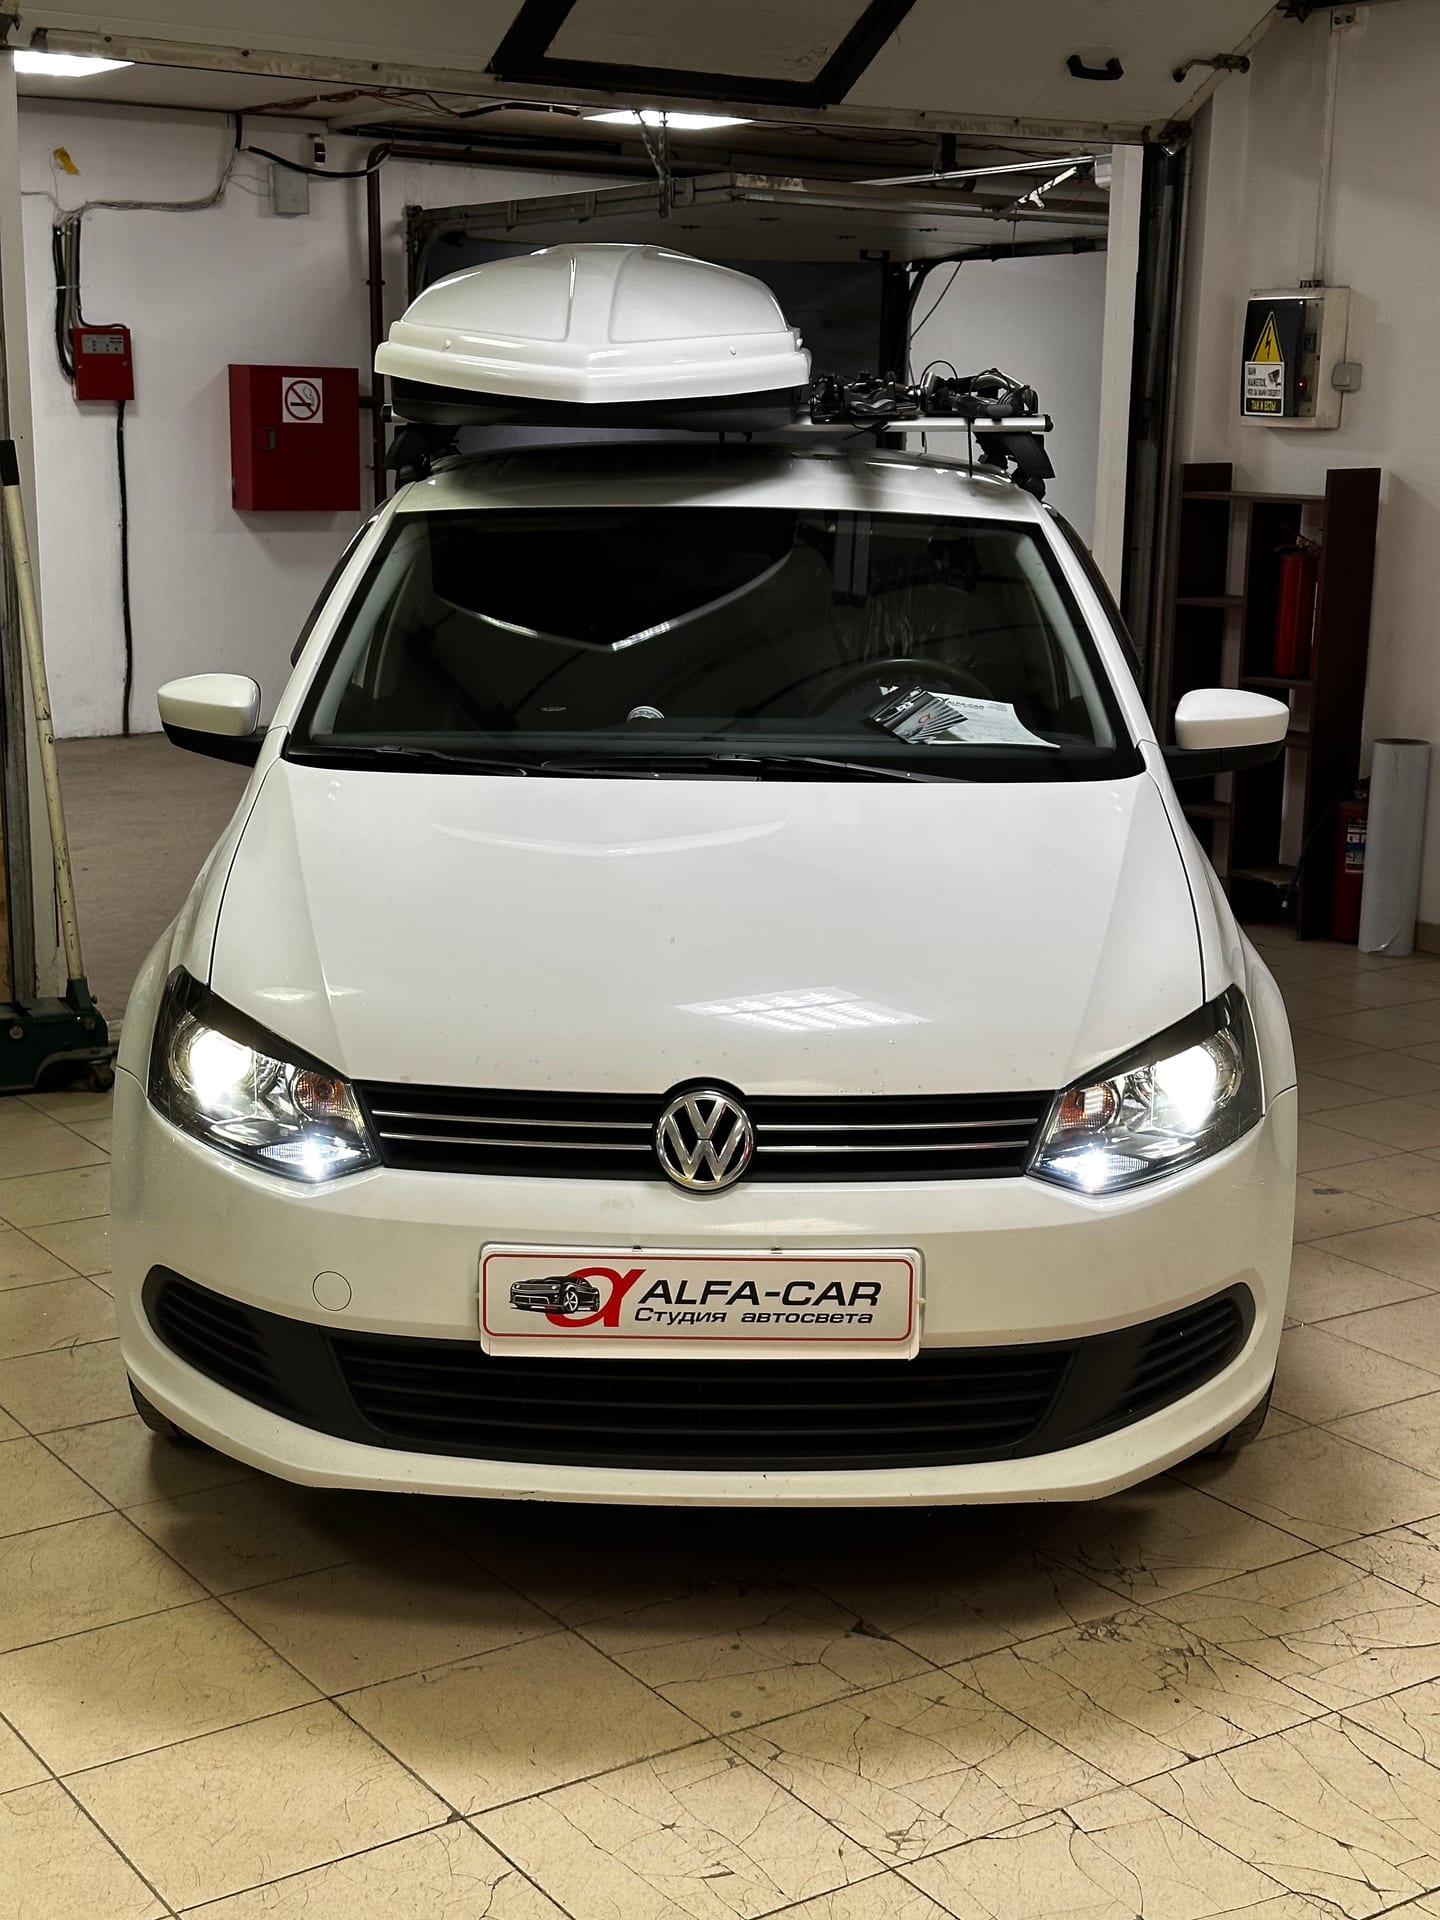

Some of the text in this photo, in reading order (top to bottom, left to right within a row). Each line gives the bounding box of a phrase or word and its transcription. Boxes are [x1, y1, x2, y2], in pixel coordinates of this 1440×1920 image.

[638, 1279, 882, 1307] ALFA-CAR
[634, 1307, 873, 1326] Студия автосвета
